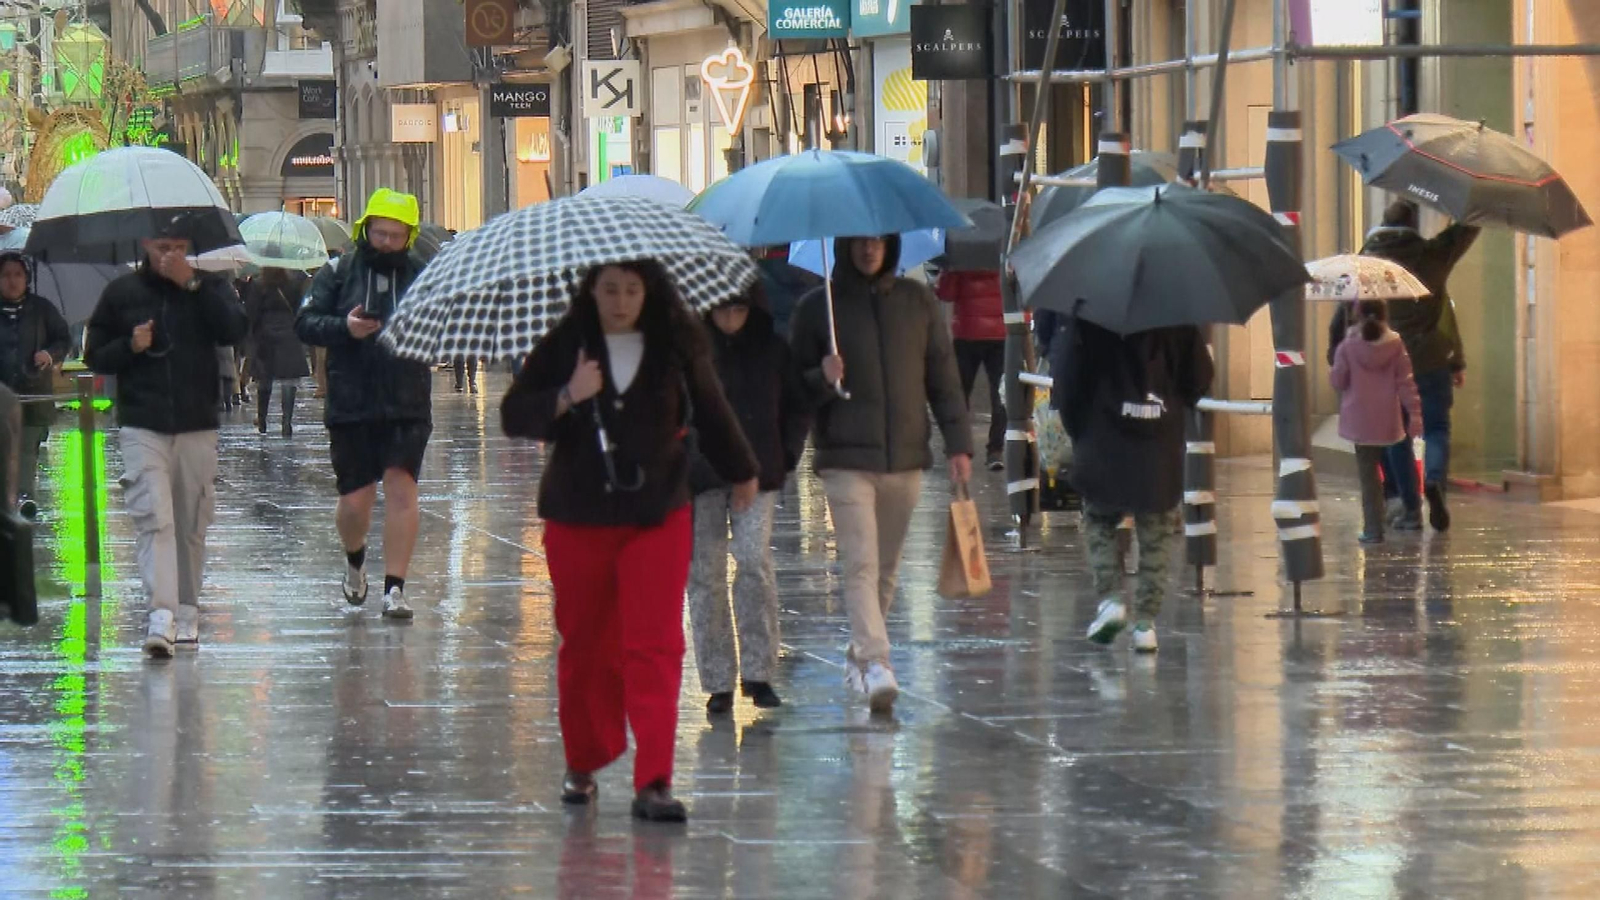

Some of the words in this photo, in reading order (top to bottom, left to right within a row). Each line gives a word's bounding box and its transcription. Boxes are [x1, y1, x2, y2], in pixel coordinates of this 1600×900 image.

[784, 5, 834, 19] GALERÍA
[775, 18, 842, 29] COMERCIAL
[916, 43, 982, 51] SCALPERS
[493, 92, 546, 102] MANGO
[1408, 184, 1439, 202] INESIS
[1122, 402, 1161, 418] PUMA
